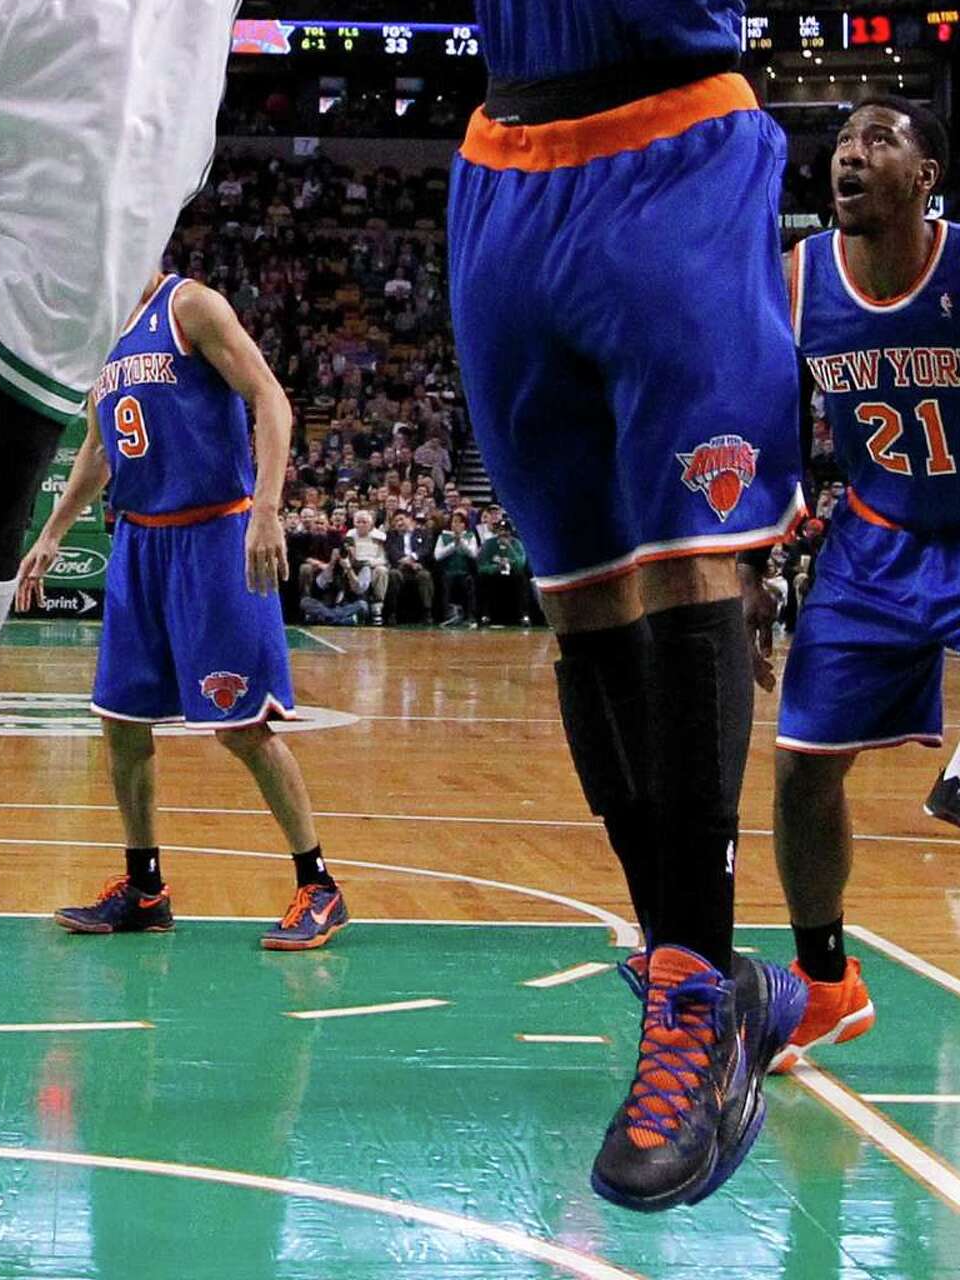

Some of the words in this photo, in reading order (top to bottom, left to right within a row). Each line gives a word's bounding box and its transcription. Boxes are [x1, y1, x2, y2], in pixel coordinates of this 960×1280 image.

[382, 26, 413, 38] FG%
[453, 27, 471, 40] FG
[384, 38, 408, 54] 33
[445, 39, 478, 56] 1/3
[121, 352, 177, 387] YORK
[806, 349, 881, 393] NEW
[884, 347, 960, 387] YOR
[114, 395, 149, 458] 9
[855, 399, 957, 477] 21
[38, 596, 78, 611] Sprint
